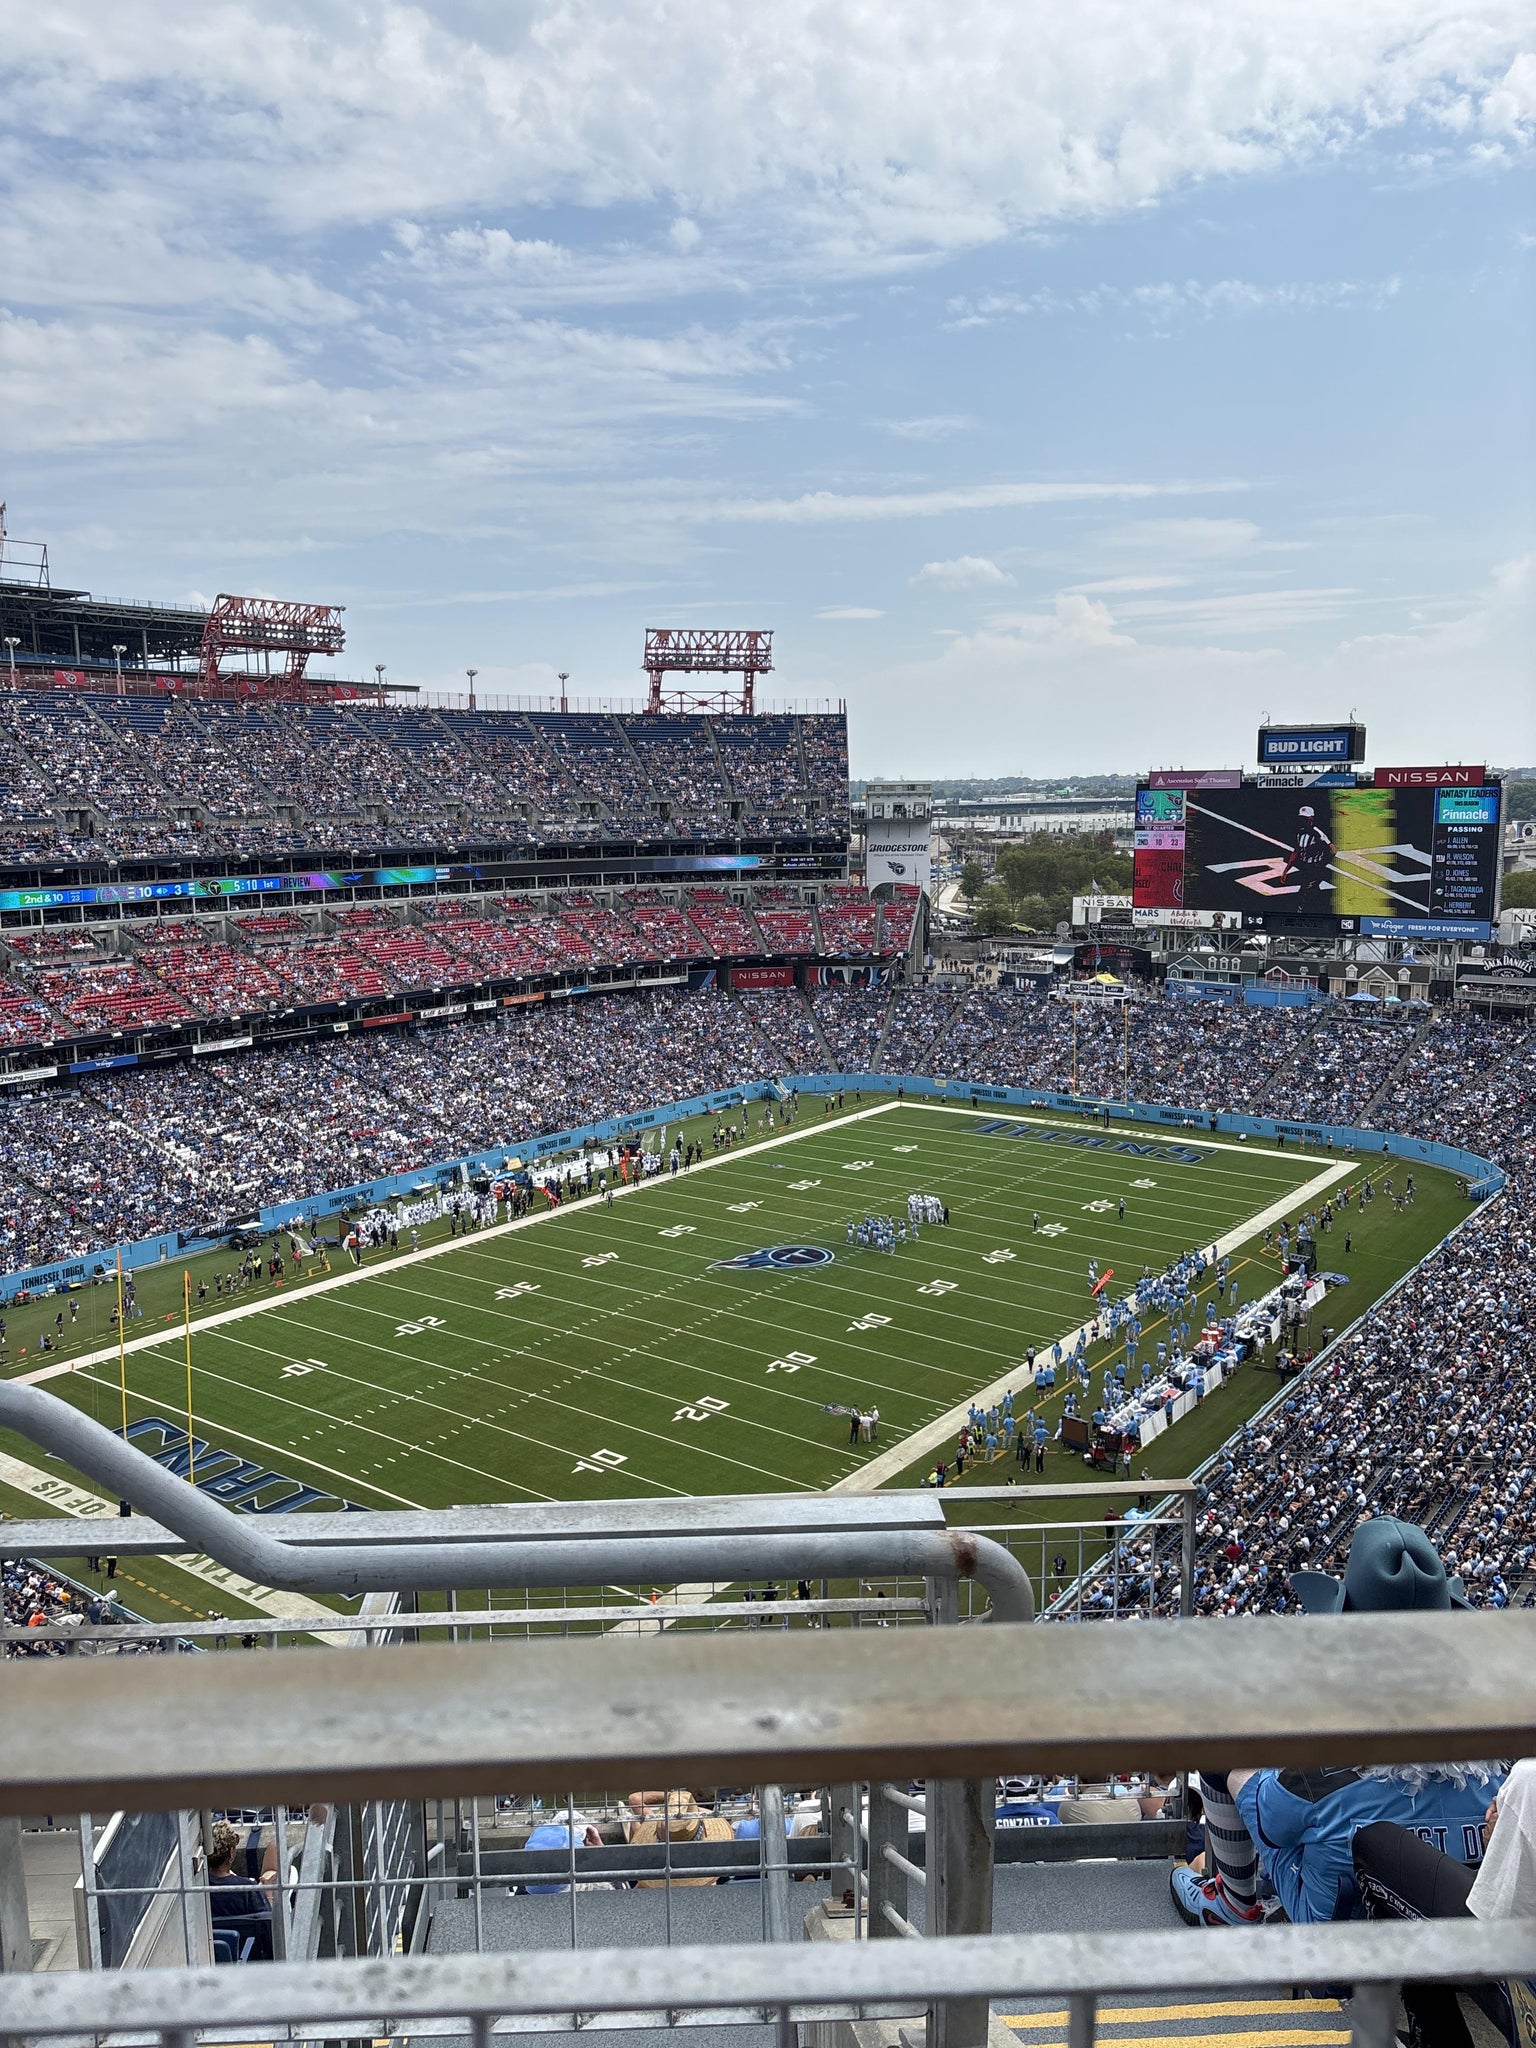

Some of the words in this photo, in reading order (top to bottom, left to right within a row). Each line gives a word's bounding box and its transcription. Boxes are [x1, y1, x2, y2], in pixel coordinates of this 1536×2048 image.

[1268, 741, 1298, 753] BUD
[1301, 740, 1343, 752] LIGHT
[1259, 776, 1303, 787] Pinnacle
[1388, 772, 1468, 782] NISSAN
[1438, 790, 1467, 798] FANTASY
[1469, 789, 1498, 797] LEADERS
[1443, 809, 1488, 819] Pinnacle
[868, 844, 929, 852] BRIDGESTONE
[174, 885, 182, 895] 3
[234, 879, 257, 891] 5:10
[263, 880, 273, 888] 1st
[283, 876, 311, 888] REVIEW
[24, 894, 43, 904] 2nd
[44, 894, 52, 903] &
[53, 893, 63, 902] 10
[139, 887, 152, 897] 10
[1082, 898, 1133, 907] NISSAN
[1381, 920, 1404, 933] Kroger
[1483, 958, 1502, 971] JACK
[1503, 955, 1534, 974] DANIEL'S
[738, 971, 786, 979] NISSAN
[961, 1118, 1218, 1164] TITANS
[892, 1145, 917, 1153] 10
[841, 1160, 872, 1171] 20
[787, 1180, 819, 1191] 30
[1129, 1179, 1157, 1189] 10
[726, 1201, 760, 1213] 40
[1081, 1200, 1116, 1213] 20
[657, 1224, 698, 1238] 50
[1036, 1224, 1069, 1238] 30
[581, 1251, 620, 1266] 40
[981, 1250, 1017, 1264] 40
[22, 1271, 59, 1289] TENNESSEE
[62, 1264, 84, 1279] TOUGH
[498, 1281, 541, 1299] 30
[917, 1278, 959, 1297] 50
[400, 1315, 447, 1335] 20
[852, 1312, 893, 1331] 40
[282, 1357, 328, 1377] 10
[772, 1351, 818, 1373] 30
[676, 1396, 731, 1421] 20
[576, 1448, 629, 1473] 10
[30, 1480, 73, 1500] US
[70, 1498, 107, 1515] OF
[237, 1585, 279, 1601] IT
